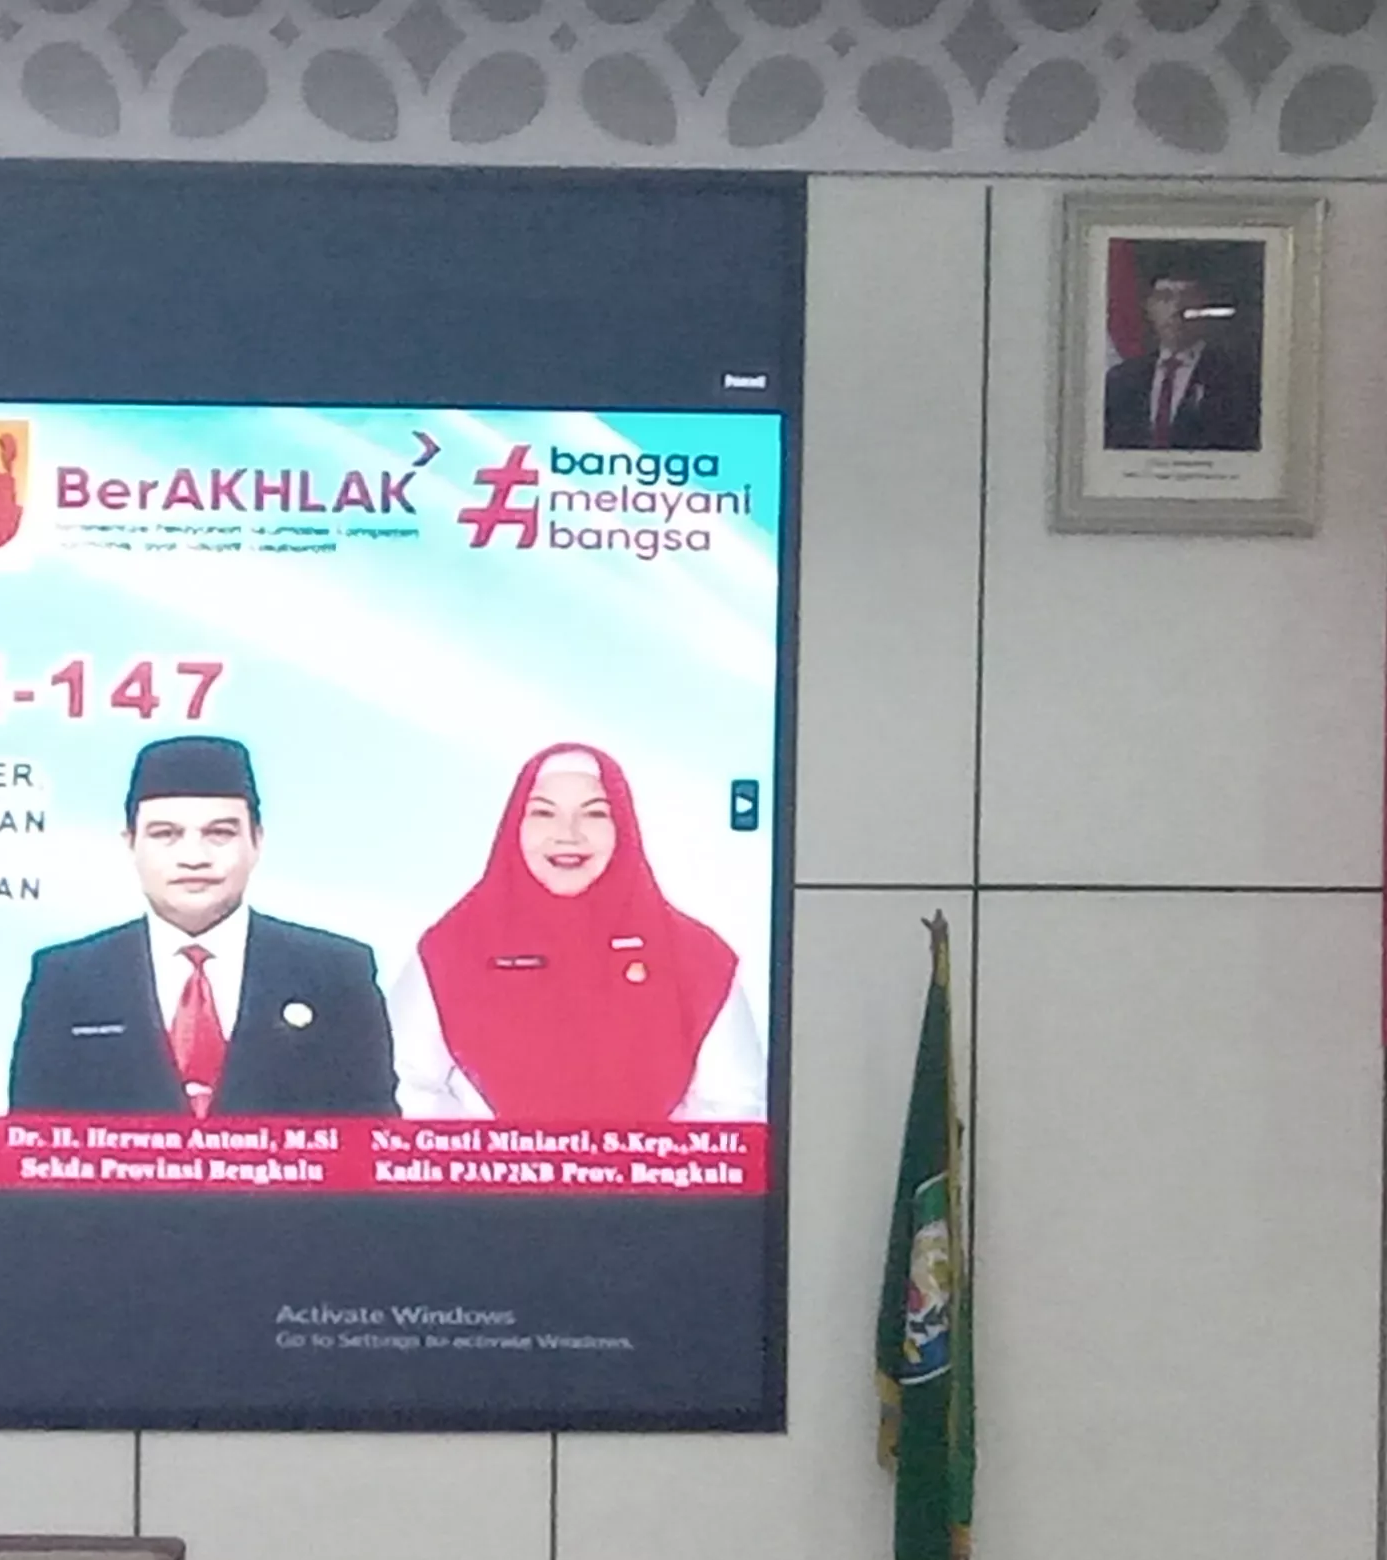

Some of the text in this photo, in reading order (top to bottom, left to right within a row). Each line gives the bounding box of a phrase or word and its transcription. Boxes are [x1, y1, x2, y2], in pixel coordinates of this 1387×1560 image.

[550, 446, 719, 486] bangga
[56, 466, 417, 514] BerAKHLAK
[550, 483, 751, 523] melayani
[550, 521, 711, 560] bangsa
[7, 1127, 47, 1148] Dr.
[87, 1128, 183, 1149] Herwan
[416, 1130, 482, 1152] Gusti
[20, 1157, 324, 1185] Sekda Provinsi Bengkulu
[561, 1162, 624, 1183] Prov.
[631, 1162, 743, 1188] Bengkulu
[276, 1304, 516, 1326] Activate Windows
[276, 1332, 305, 1348] Go
[312, 1332, 333, 1348] to
